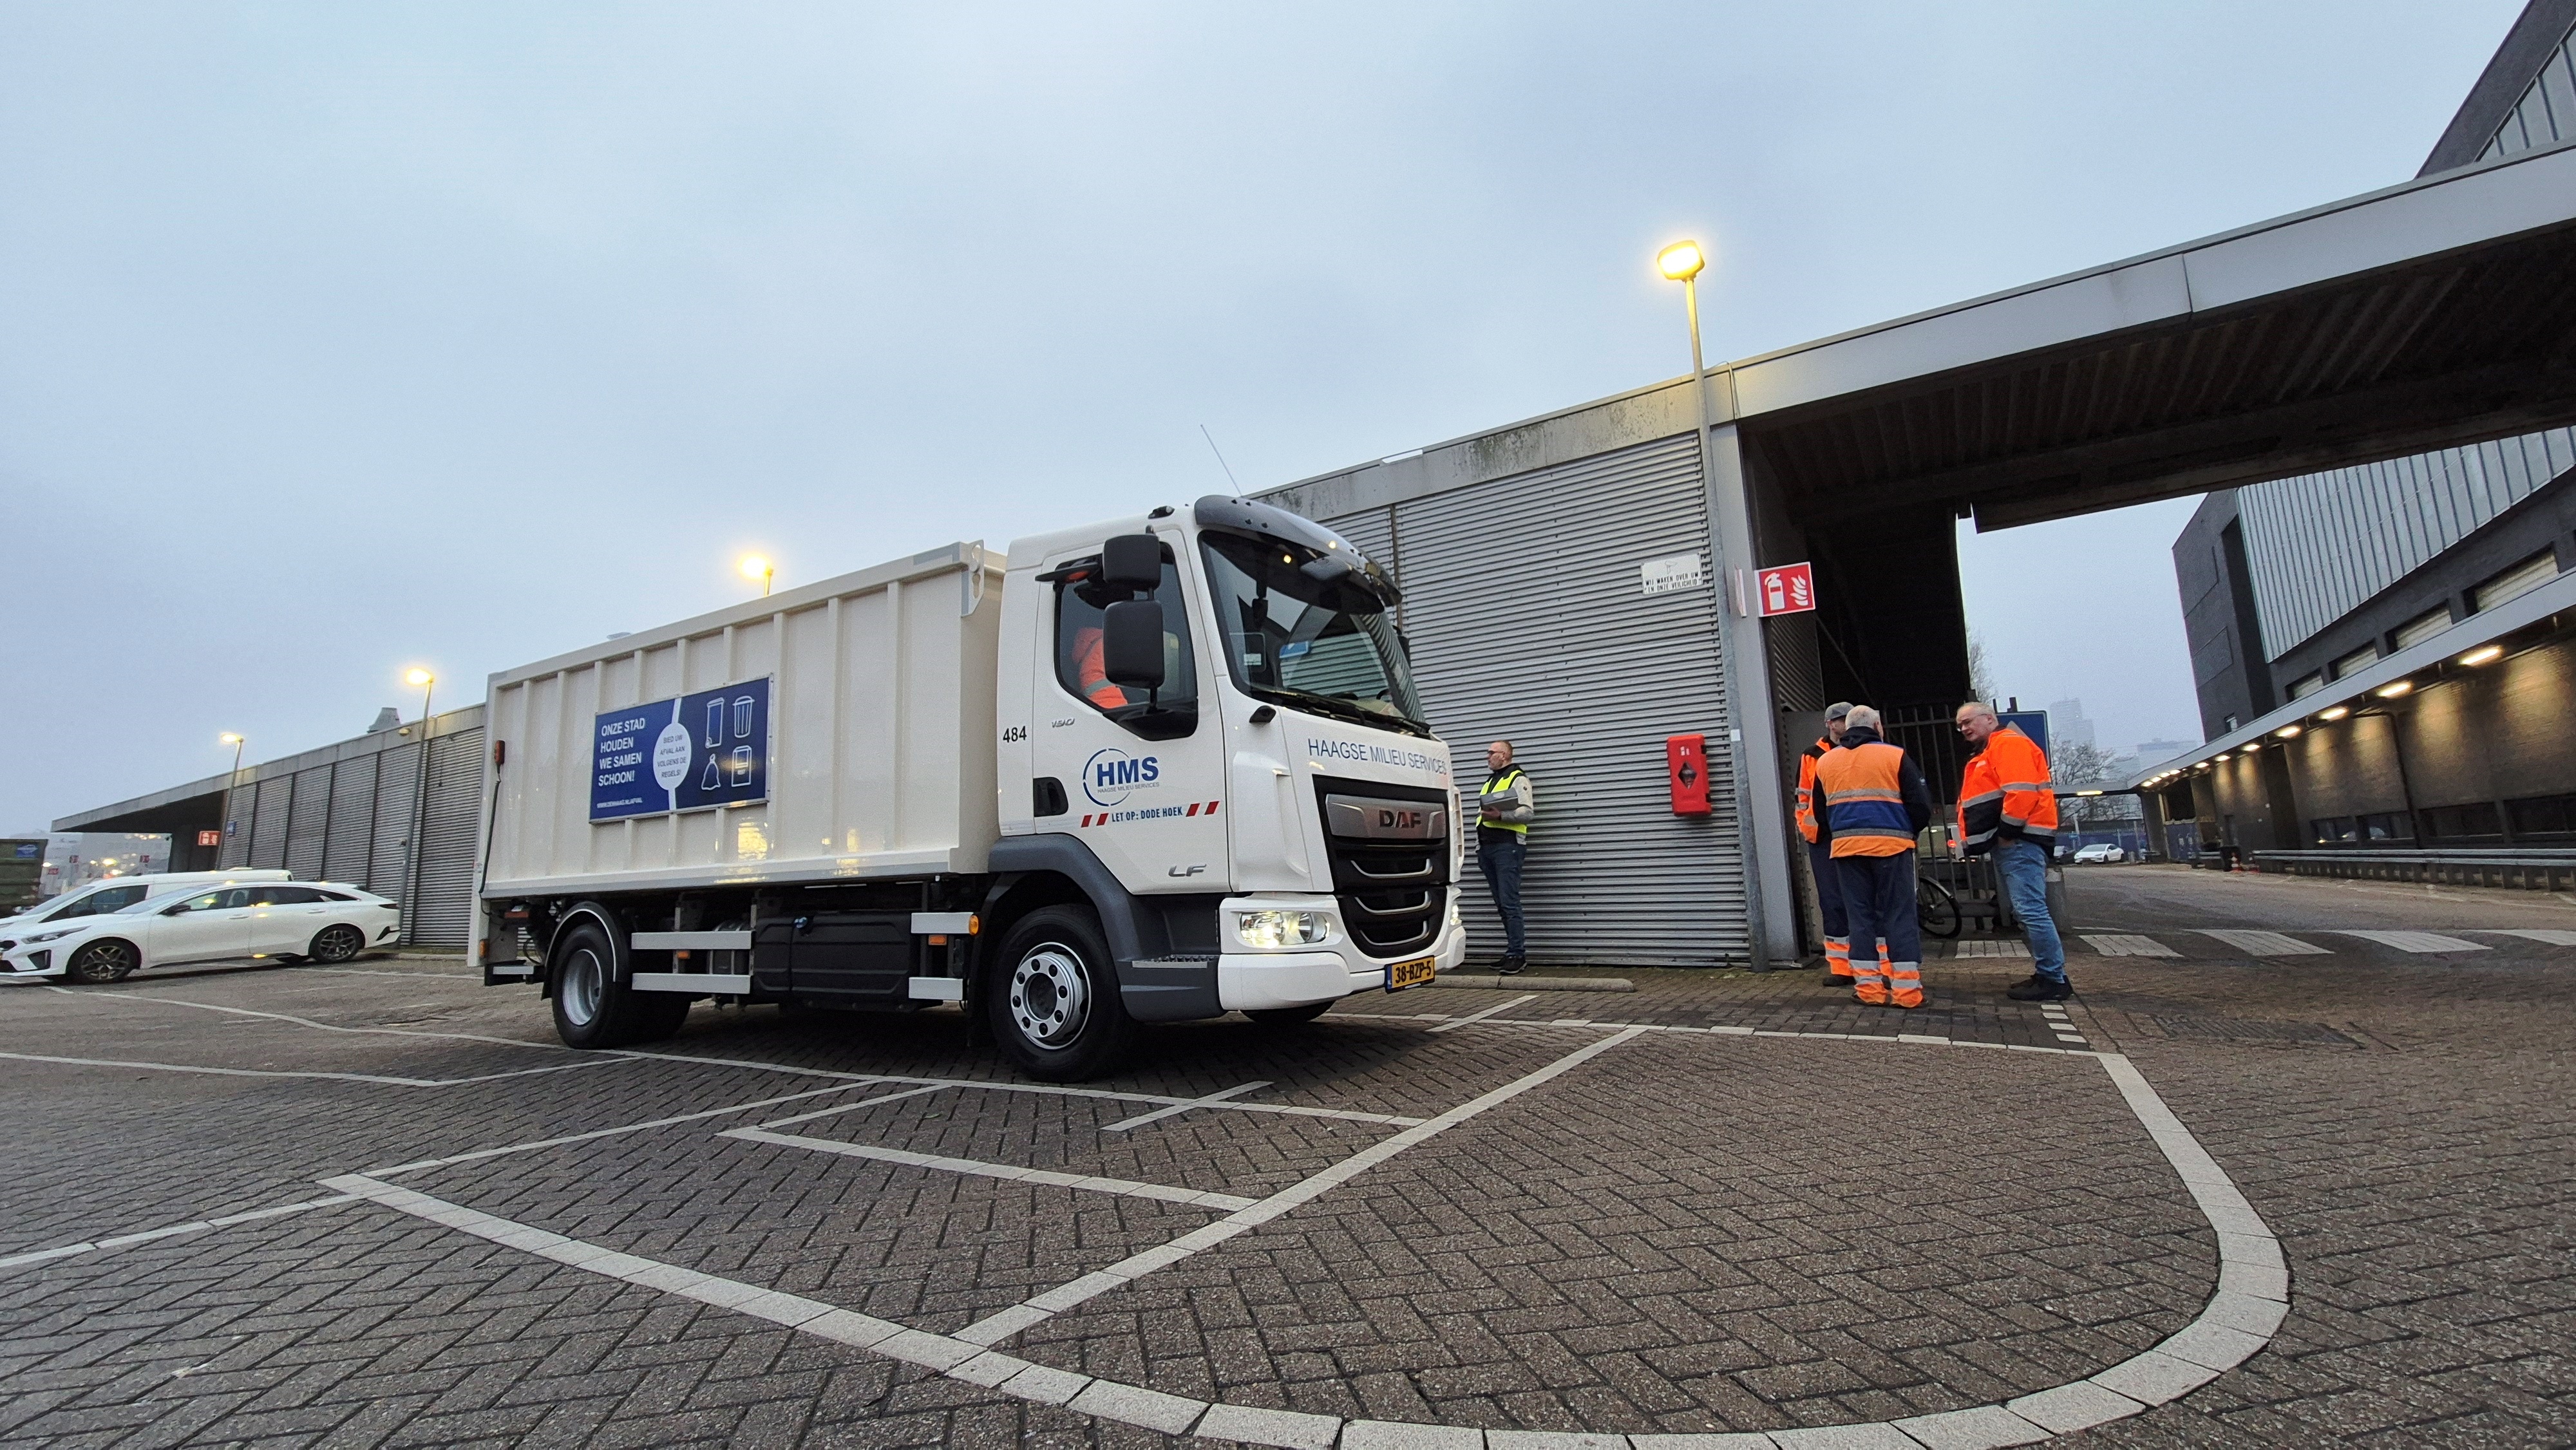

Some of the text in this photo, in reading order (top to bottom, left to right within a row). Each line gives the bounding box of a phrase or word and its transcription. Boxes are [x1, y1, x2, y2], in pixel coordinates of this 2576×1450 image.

[1657, 583, 1668, 591] ONZE
[601, 717, 645, 737] ONZE STAD
[1003, 725, 1027, 743] 484
[600, 737, 634, 753] HOUDEN
[600, 751, 642, 770] WE SAMEN
[1308, 739, 1448, 775] HAAGSE MILIEU SERVICES
[598, 770, 635, 787] SCHOON!
[1097, 756, 1159, 787] HMS
[1135, 782, 1160, 790] SERVICES
[1112, 806, 1183, 822] LET OP: DODE HOEK
[1378, 809, 1422, 829] DAF
[1168, 863, 1207, 877] LF
[1395, 960, 1432, 984] 38-BZP-5
